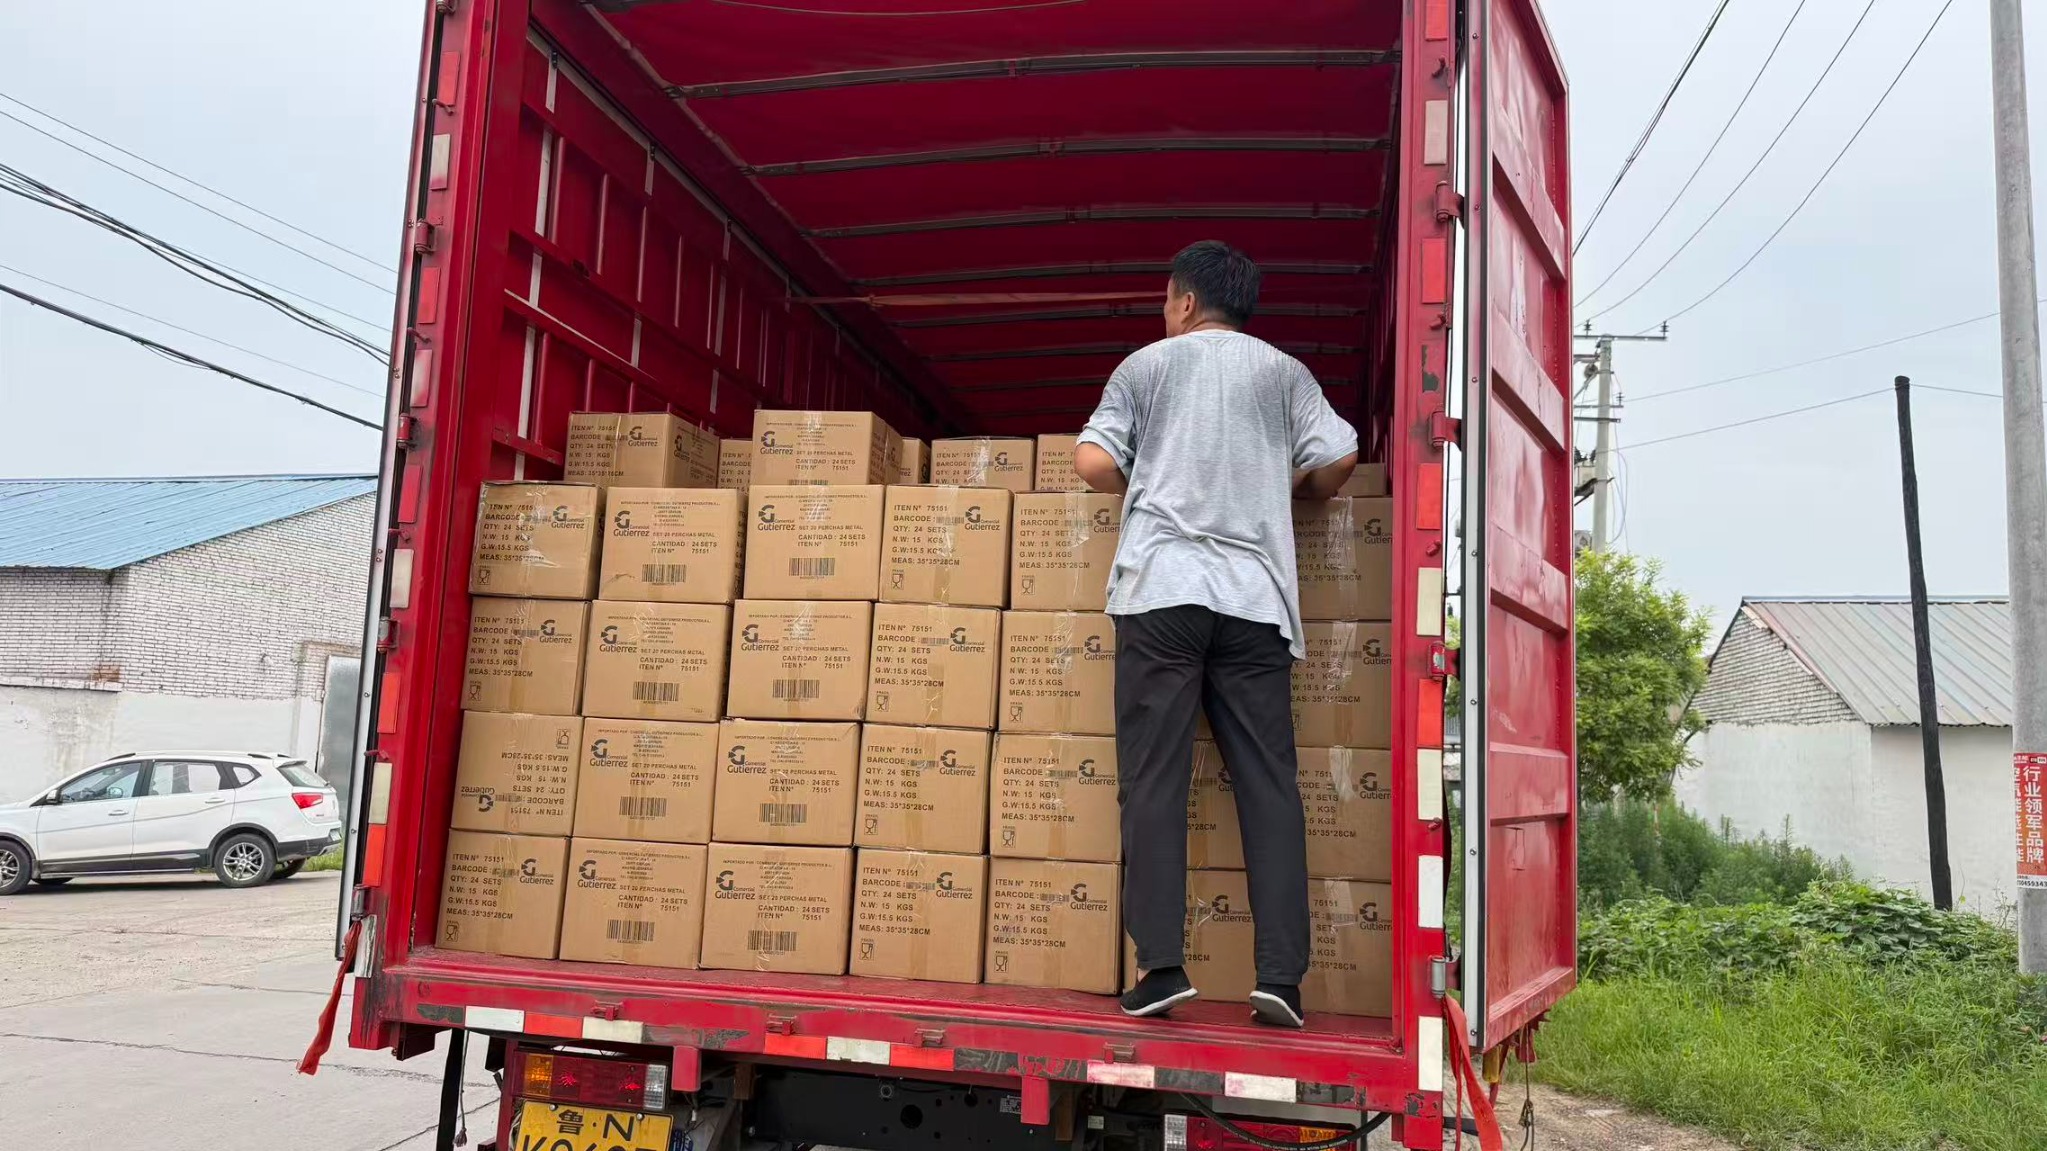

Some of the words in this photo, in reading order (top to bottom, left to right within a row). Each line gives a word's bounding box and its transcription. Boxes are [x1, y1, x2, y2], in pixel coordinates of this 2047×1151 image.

[760, 447, 793, 455] Gutierrez
[551, 521, 584, 529] Gutierrez
[758, 523, 795, 531] Gutierrez
[950, 644, 985, 652] Gutierrez
[590, 758, 628, 768] Gutierrez
[867, 757, 904, 765] BARCODE
[940, 767, 976, 776] Gutierrez
[1079, 777, 1116, 785] Gutierrez
[461, 786, 495, 795] Gutierrez
[511, 807, 531, 815] 75151
[2023, 766, 2044, 863] 行业领军品牌
[452, 864, 487, 873] BARCODE
[520, 876, 554, 885] Gutierrez
[577, 879, 616, 889] Gutierrez
[862, 879, 901, 887] BARCODE
[619, 894, 654, 903] CANTIDAD
[715, 890, 755, 900] Gutierrez
[936, 890, 972, 899] Gutierrez
[1070, 902, 1107, 911] Gutierrez
[1212, 913, 1251, 923] Gutierrez
[859, 924, 883, 932] MEAS:
